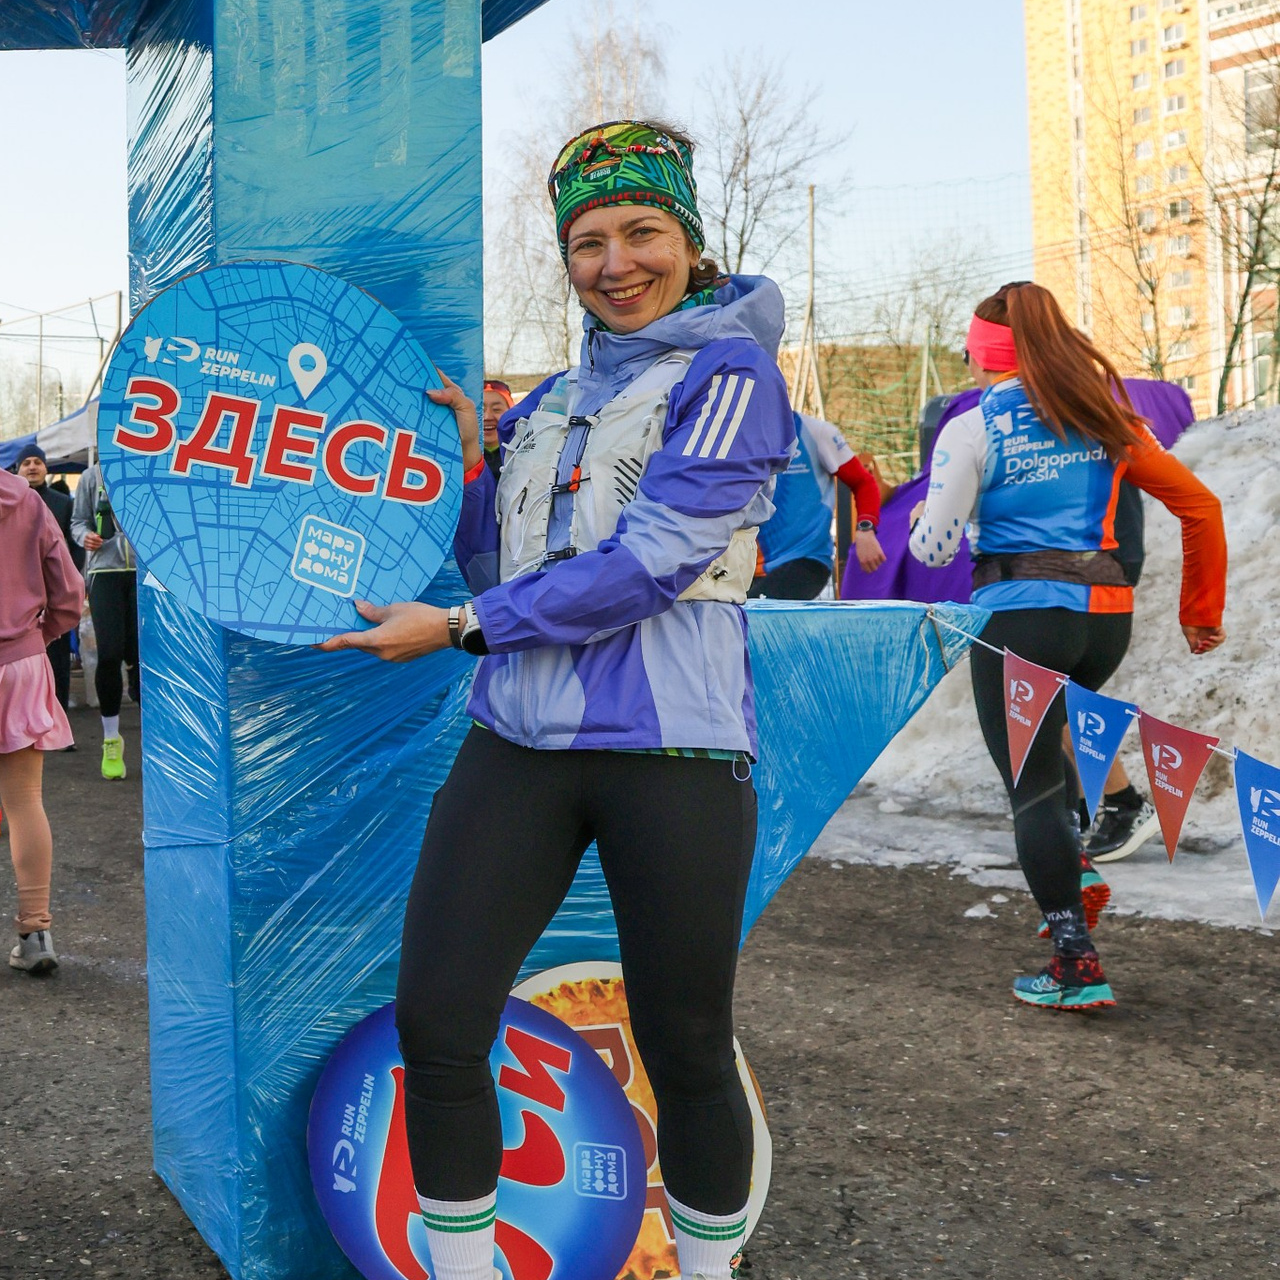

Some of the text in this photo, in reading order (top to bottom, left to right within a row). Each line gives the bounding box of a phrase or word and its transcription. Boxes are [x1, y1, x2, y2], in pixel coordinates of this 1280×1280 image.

[205, 347, 240, 365] RUN
[200, 362, 276, 387] ZEPPELIN
[112, 375, 445, 506] ЗДЕСЬ
[1003, 435, 1029, 448] RUN
[1003, 440, 1055, 457] ZEPPELIN
[308, 526, 355, 553] мара
[304, 539, 354, 571] фону
[299, 557, 349, 585] дома
[1079, 743, 1106, 762] ZEPPELIN
[1155, 770, 1169, 782] RUN
[1155, 779, 1184, 798] ZEPPELIN
[1252, 816, 1268, 830] RUN
[341, 1103, 356, 1137] RUN
[353, 1073, 375, 1144] ZEPPELIN
[582, 1150, 593, 1190] мара
[592, 1149, 607, 1192] фону
[607, 1152, 619, 1194] дома
